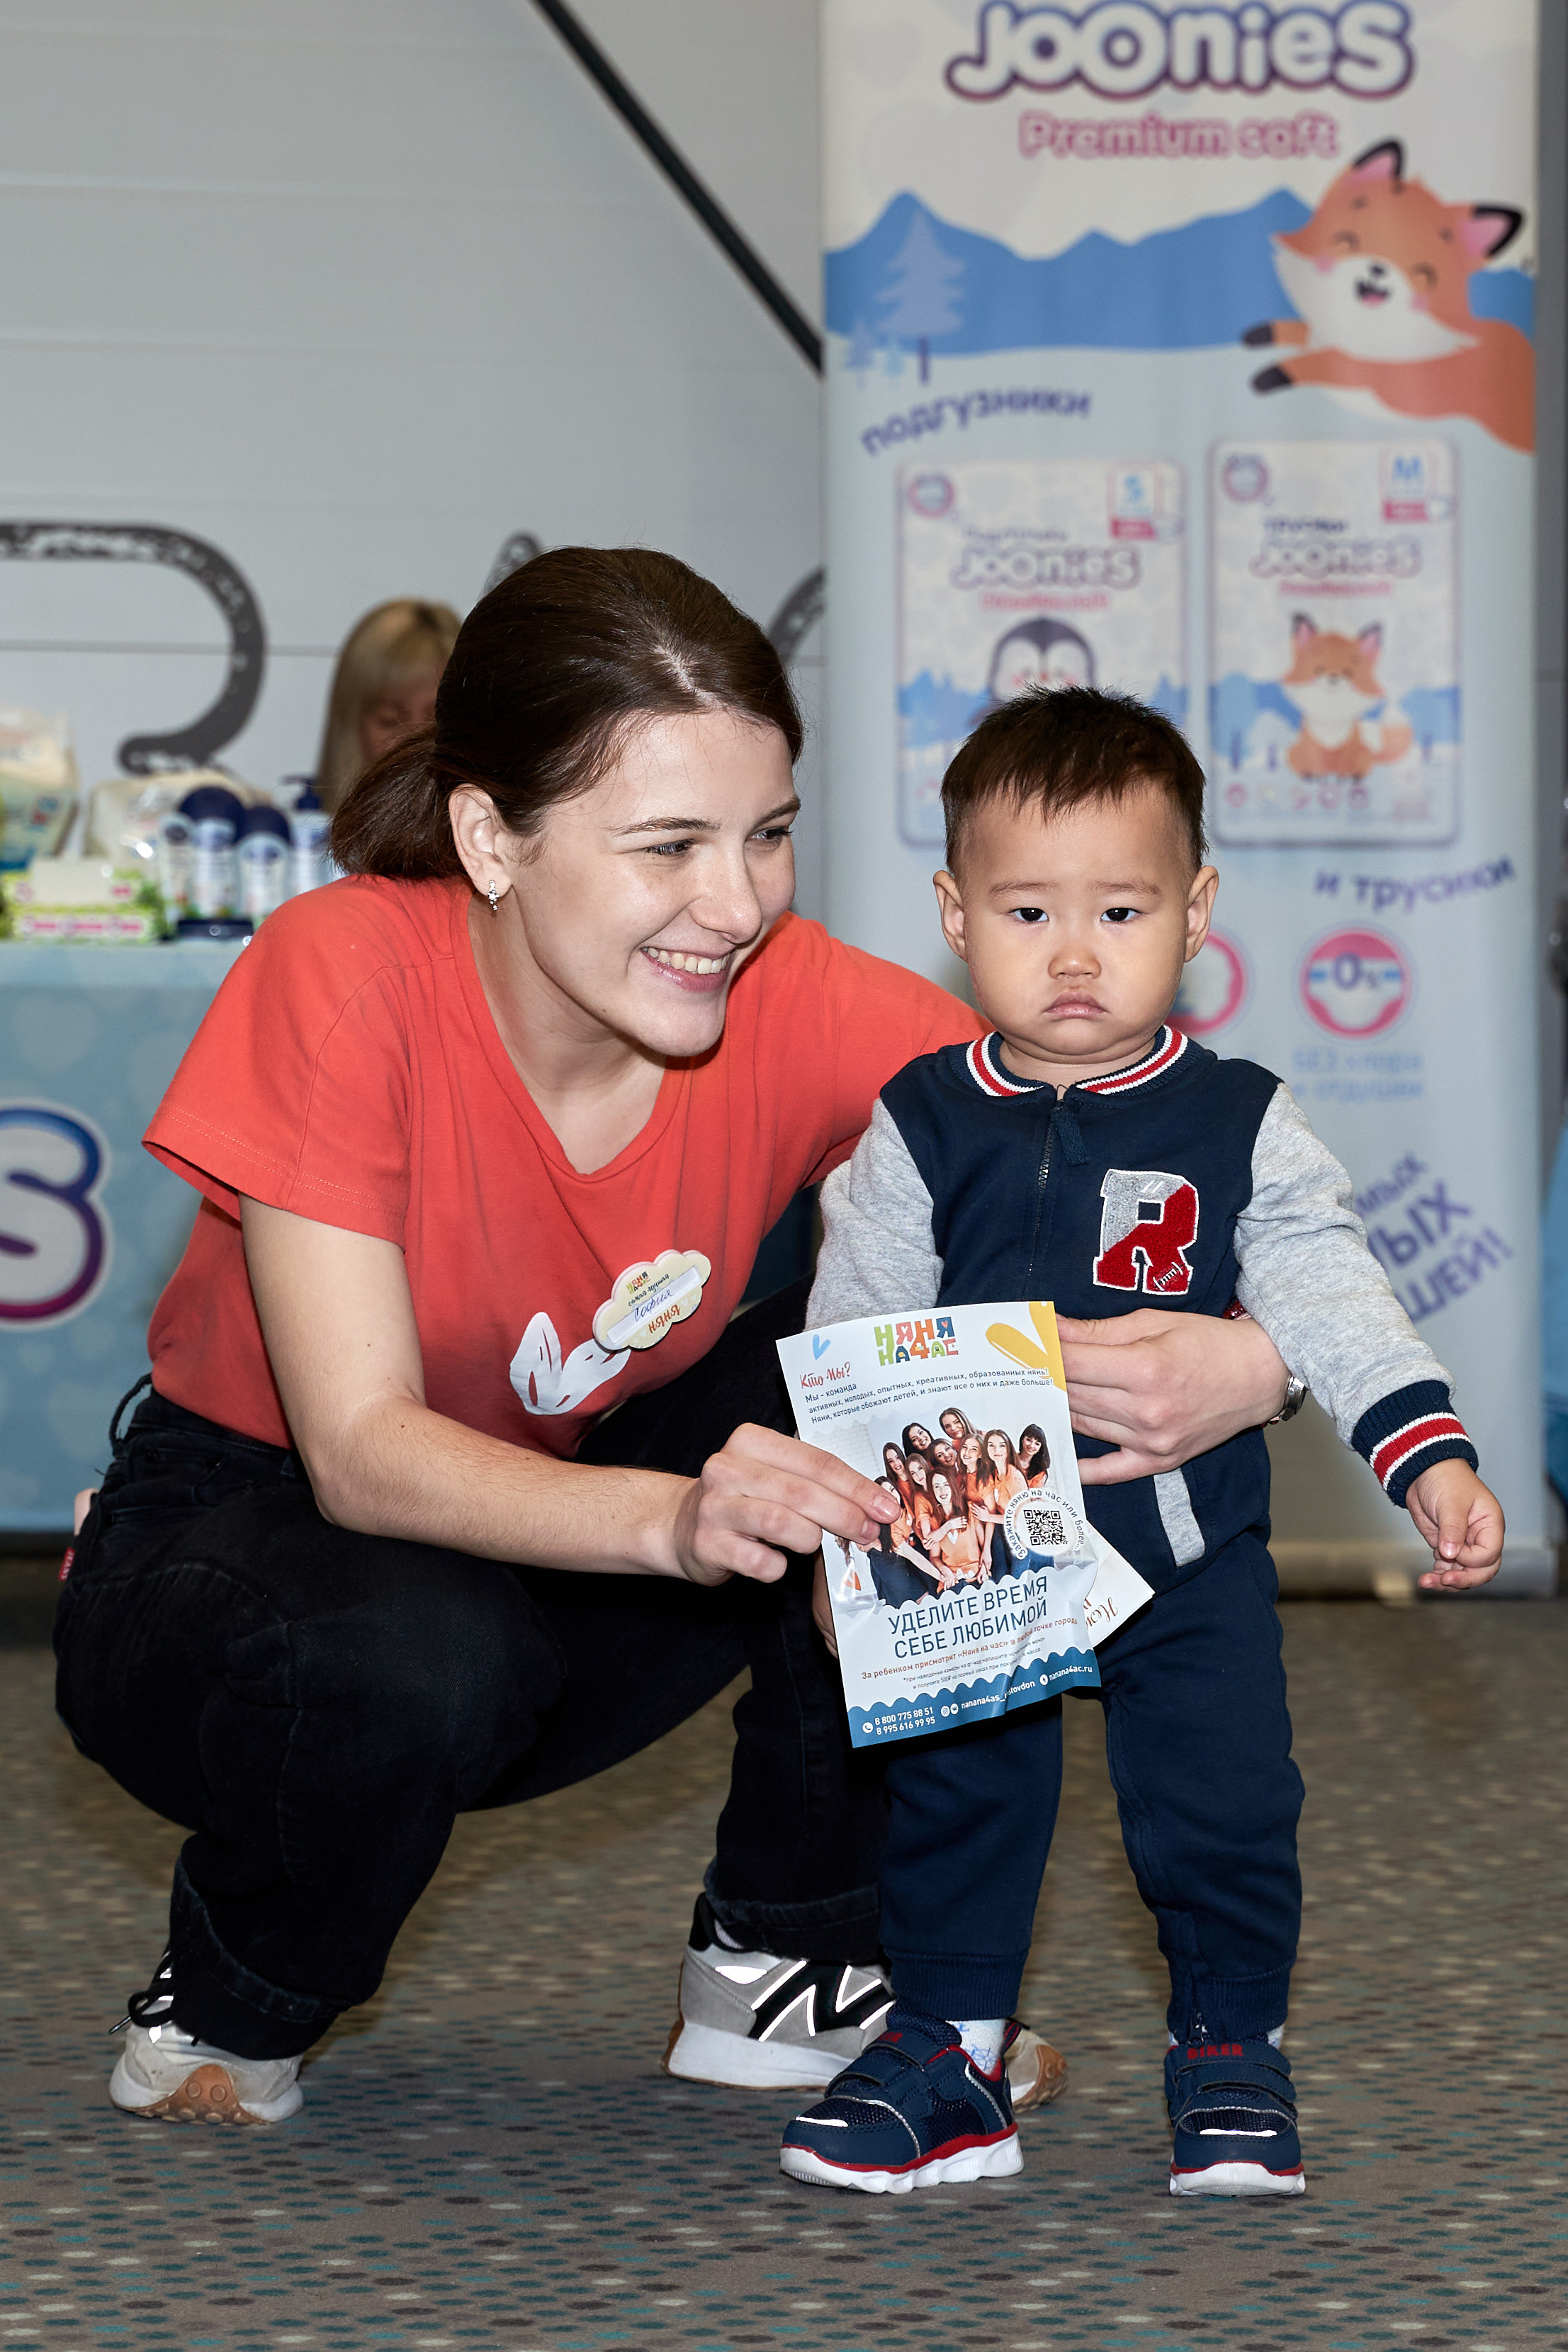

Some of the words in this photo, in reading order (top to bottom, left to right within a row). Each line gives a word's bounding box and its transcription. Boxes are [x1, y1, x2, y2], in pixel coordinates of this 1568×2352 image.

[1017, 110, 1234, 160] Premium
[1236, 108, 1341, 160] soft
[860, 388, 1091, 456] подгузники
[1314, 871, 1341, 899] и
[1353, 855, 1516, 914] трусики
[1093, 1169, 1200, 1295] R
[1394, 1226, 1514, 1323] ШЕЙ!
[874, 1316, 955, 1347] НЯНЯ
[799, 1372, 824, 1389] Кто
[805, 1394, 820, 1403] Мы
[825, 1383, 857, 1397] команда
[808, 1400, 844, 1414] активных,
[844, 1390, 876, 1404] молодых,
[877, 1381, 914, 1394] опытных,
[916, 1373, 967, 1386] креативных,
[969, 1369, 1026, 1379] образованных
[811, 1413, 833, 1424] Няни,
[861, 1396, 891, 1409] обожают
[893, 1390, 918, 1402] детей,
[927, 1385, 952, 1393] знают
[1010, 1491, 1029, 1509] няню
[1045, 1491, 1061, 1502] час
[1063, 1501, 1078, 1518] или
[1006, 1509, 1026, 1558] Закажите
[888, 1596, 979, 1636] УДЕЛИТЕ
[983, 1575, 1047, 1611] ВРЕМЯ
[894, 1630, 947, 1658] СЕБЕ
[952, 1596, 1047, 1646] ЛЮБИМОЙ
[862, 1671, 872, 1679] За
[874, 1664, 913, 1679] ребенком
[915, 1654, 956, 1670] присмотрит
[958, 1648, 979, 1658] «Няня
[991, 1640, 1008, 1649] час»
[1034, 1622, 1053, 1633] точке
[1049, 1665, 1093, 1681] nanana4ac.ru
[874, 1717, 881, 1726] 8
[881, 1714, 896, 1724] 800
[897, 1711, 912, 1721] 775
[913, 1709, 923, 1718] 88
[924, 1706, 933, 1716] 51
[876, 1727, 882, 1735] 8
[883, 1723, 898, 1734] 995
[899, 1721, 913, 1731] 616
[915, 1718, 925, 1728] 99
[925, 1716, 935, 1726] 95
[1187, 2044, 1244, 2060] BIKER
